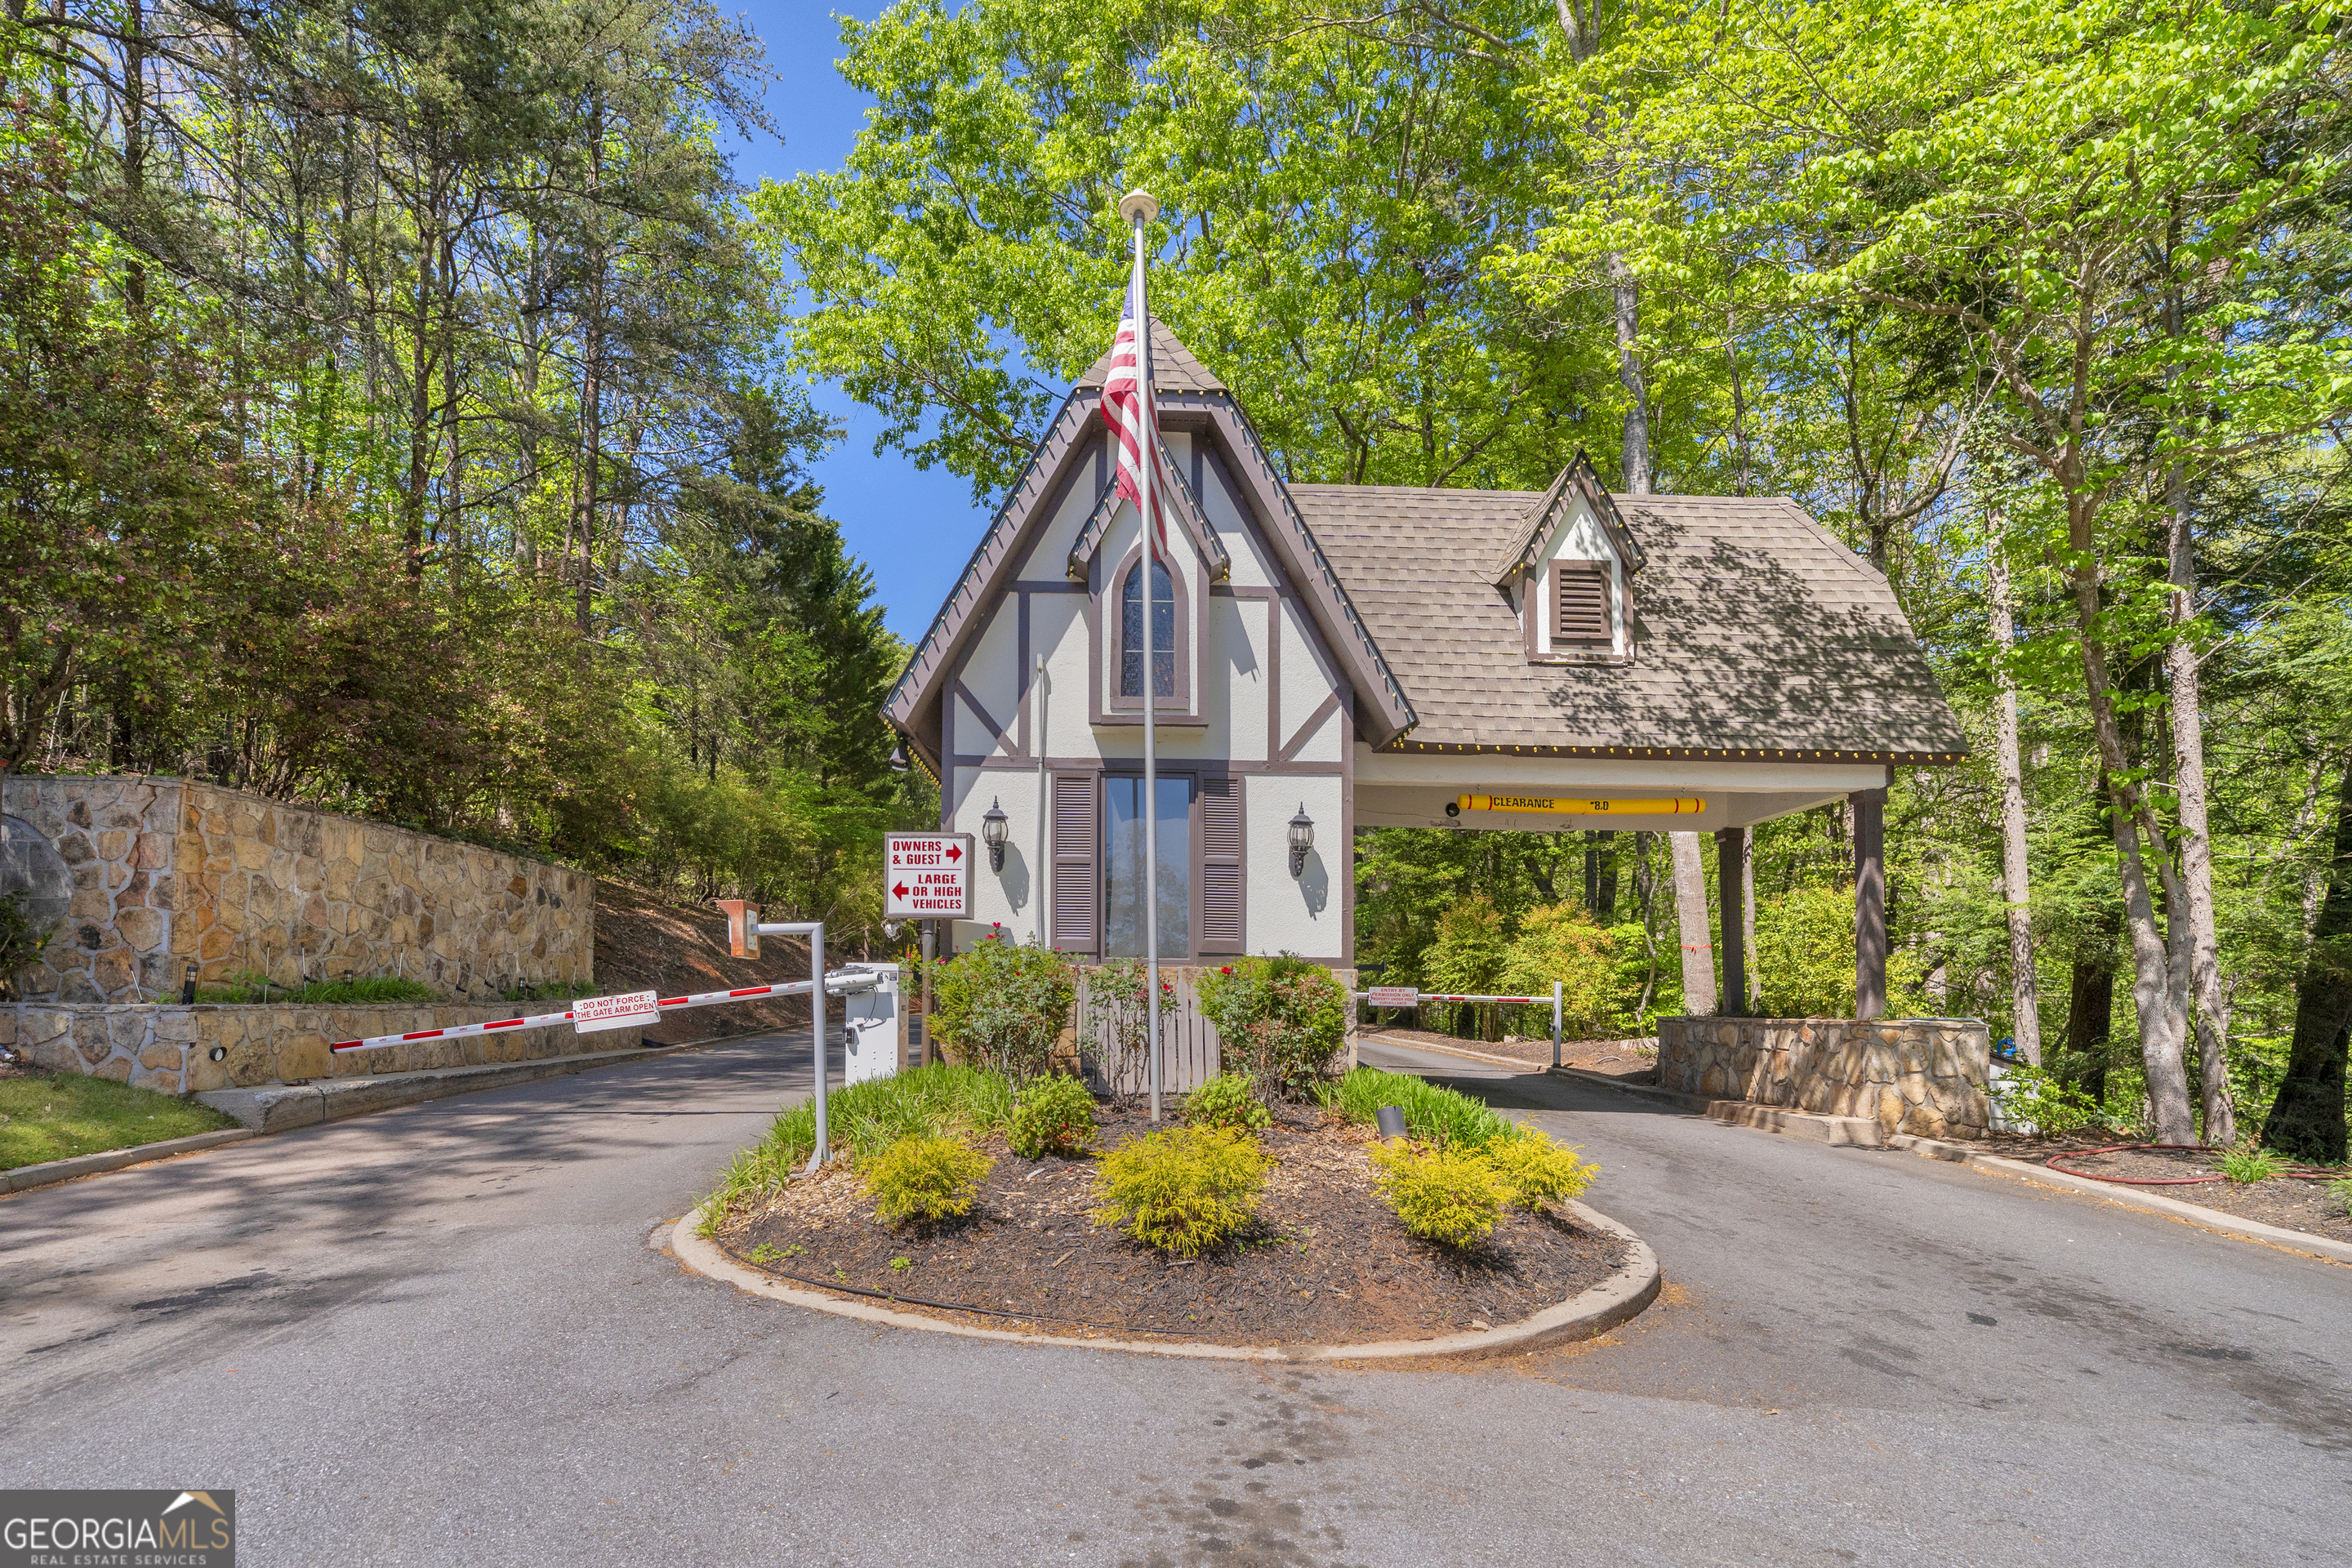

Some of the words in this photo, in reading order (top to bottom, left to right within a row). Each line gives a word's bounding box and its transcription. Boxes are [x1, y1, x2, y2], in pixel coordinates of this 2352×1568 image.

[1494, 796, 1555, 808] CLEARANCE
[893, 840, 942, 851] OWNERS
[893, 854, 902, 865] &
[906, 854, 942, 865] GUEST
[918, 874, 956, 884] LARGE
[913, 886, 928, 897] OR
[934, 887, 961, 897] HIGH
[913, 899, 962, 910] VEHICLES
[583, 1001, 595, 1009] DO
[597, 999, 613, 1008] NOT
[617, 995, 645, 1005] FORCE
[577, 1010, 591, 1019] THE
[593, 1008, 612, 1017] GATE
[614, 1004, 631, 1014] ARM
[633, 1002, 654, 1012] OPEN
